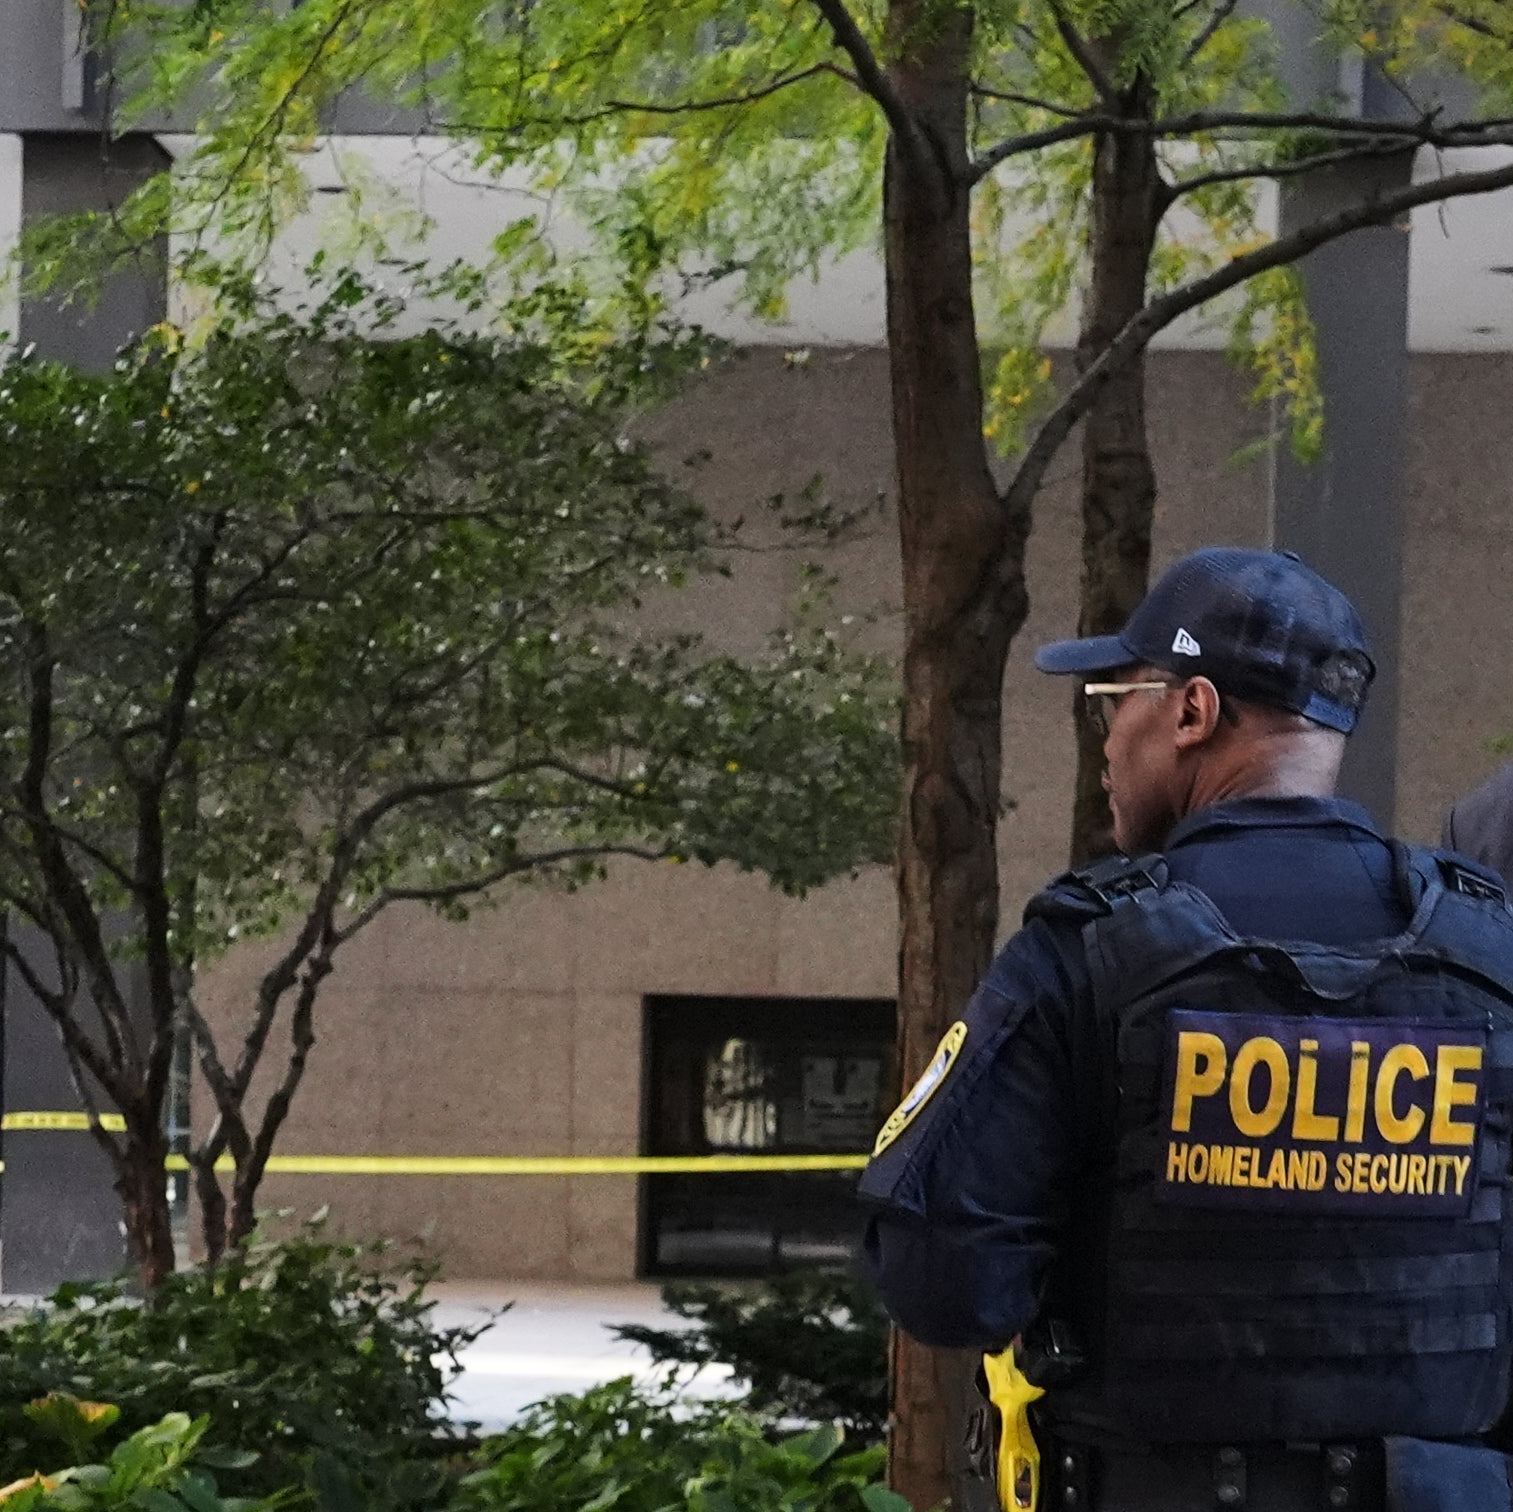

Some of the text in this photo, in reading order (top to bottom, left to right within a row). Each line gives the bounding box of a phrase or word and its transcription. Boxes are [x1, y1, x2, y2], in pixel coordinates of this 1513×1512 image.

[1171, 1031, 1483, 1146] POLICE
[1166, 1141, 1471, 1197] HOMELAND SECURITY
